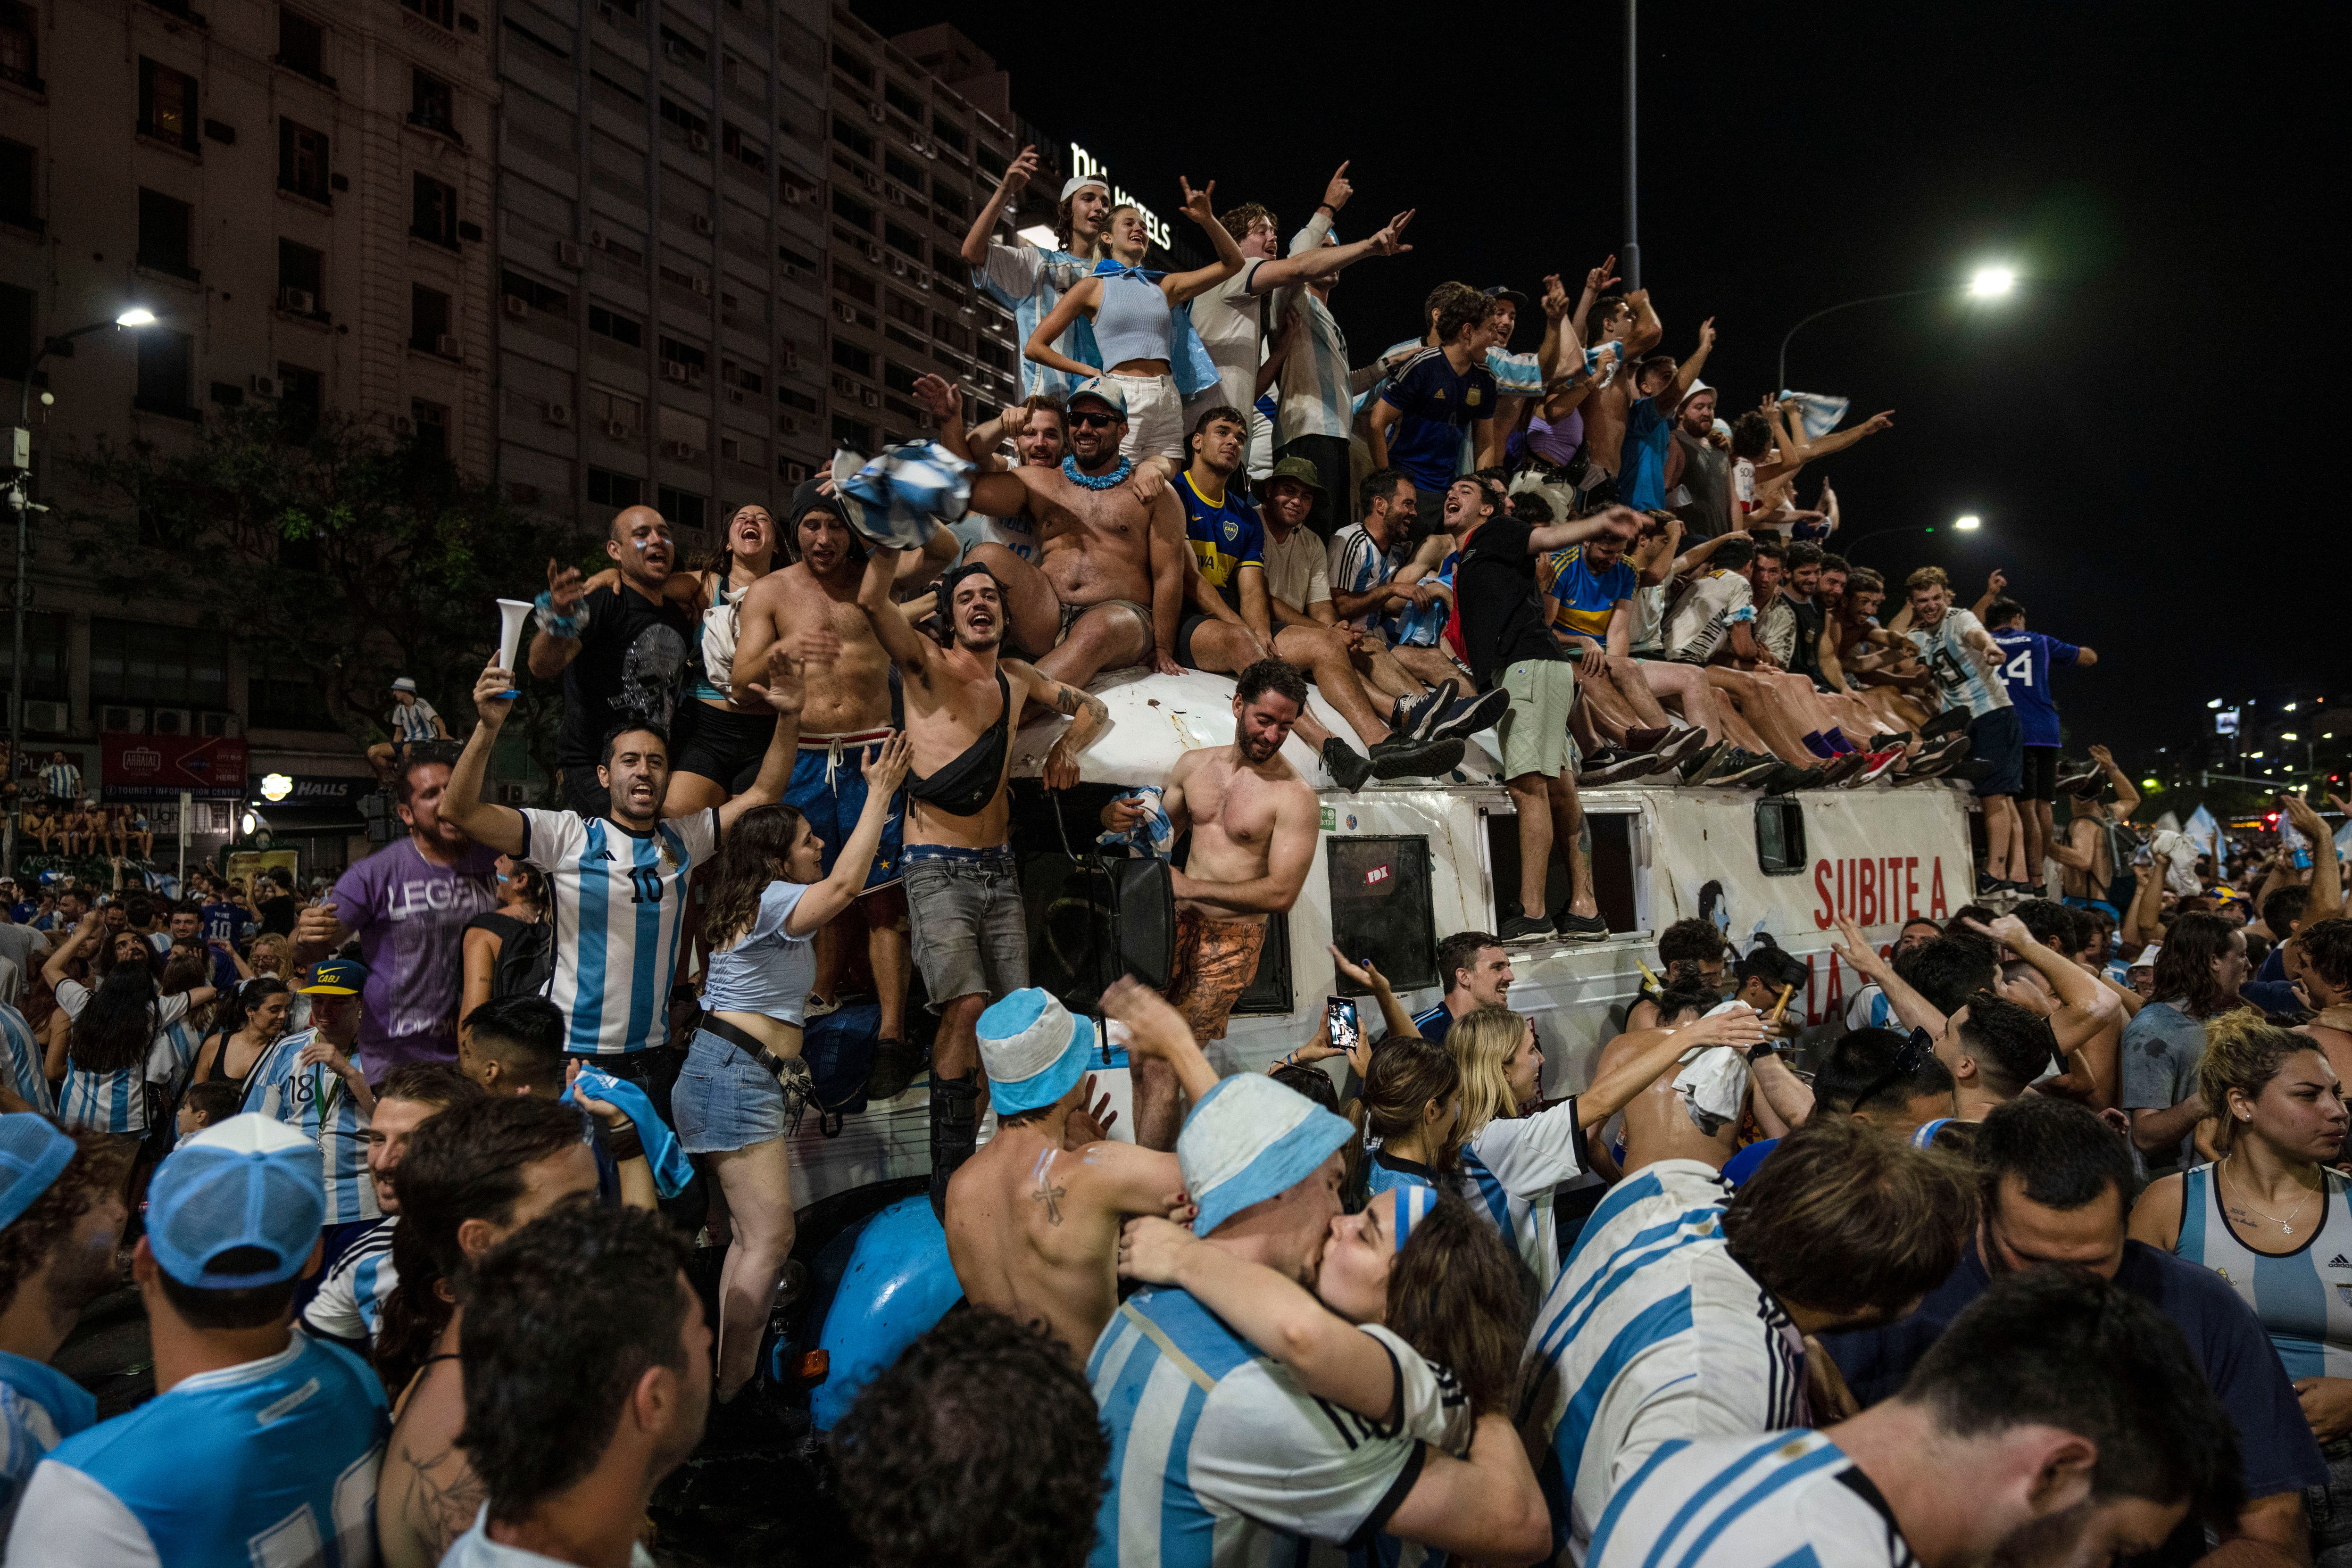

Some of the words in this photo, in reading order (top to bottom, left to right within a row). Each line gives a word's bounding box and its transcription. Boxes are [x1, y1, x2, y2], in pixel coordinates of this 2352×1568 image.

[117, 786, 151, 795] TOURIST
[155, 786, 209, 796] INFORMATION
[212, 788, 241, 796] CENTER
[297, 781, 348, 796] HALLS
[627, 867, 664, 904] 10
[1814, 857, 1920, 930] SUBITE
[1931, 856, 1948, 920] A
[210, 920, 232, 940] 10
[317, 974, 341, 984] CABJ
[1807, 952, 1844, 1027] LA
[289, 1074, 315, 1104] 18
